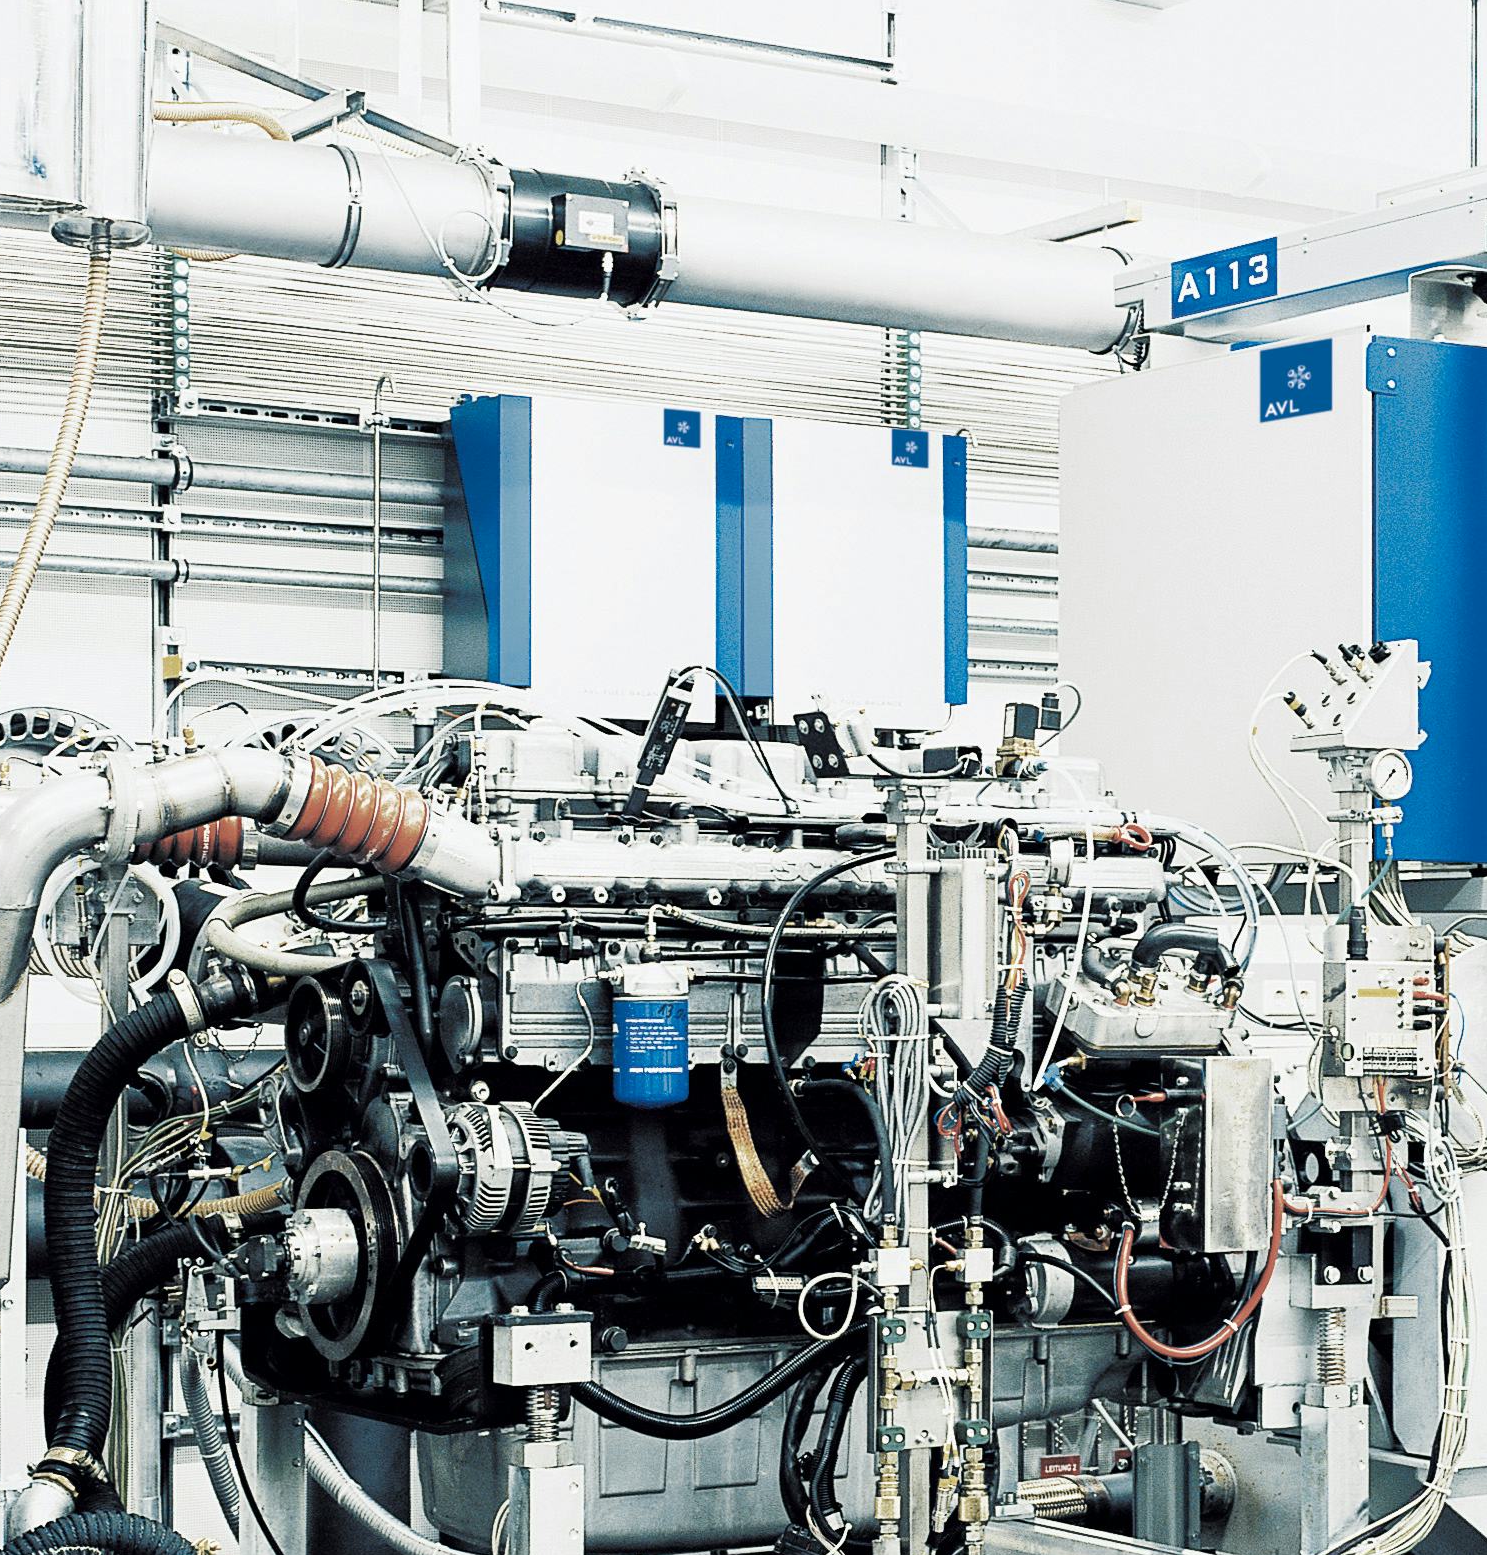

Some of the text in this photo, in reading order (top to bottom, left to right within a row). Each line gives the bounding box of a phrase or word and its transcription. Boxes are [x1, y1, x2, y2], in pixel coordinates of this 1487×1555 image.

[1177, 254, 1269, 303] A113
[1265, 399, 1300, 418] AVL
[666, 436, 684, 445] AVL
[894, 455, 913, 465] AVL
[1044, 1464, 1072, 1474] LEITUNG
